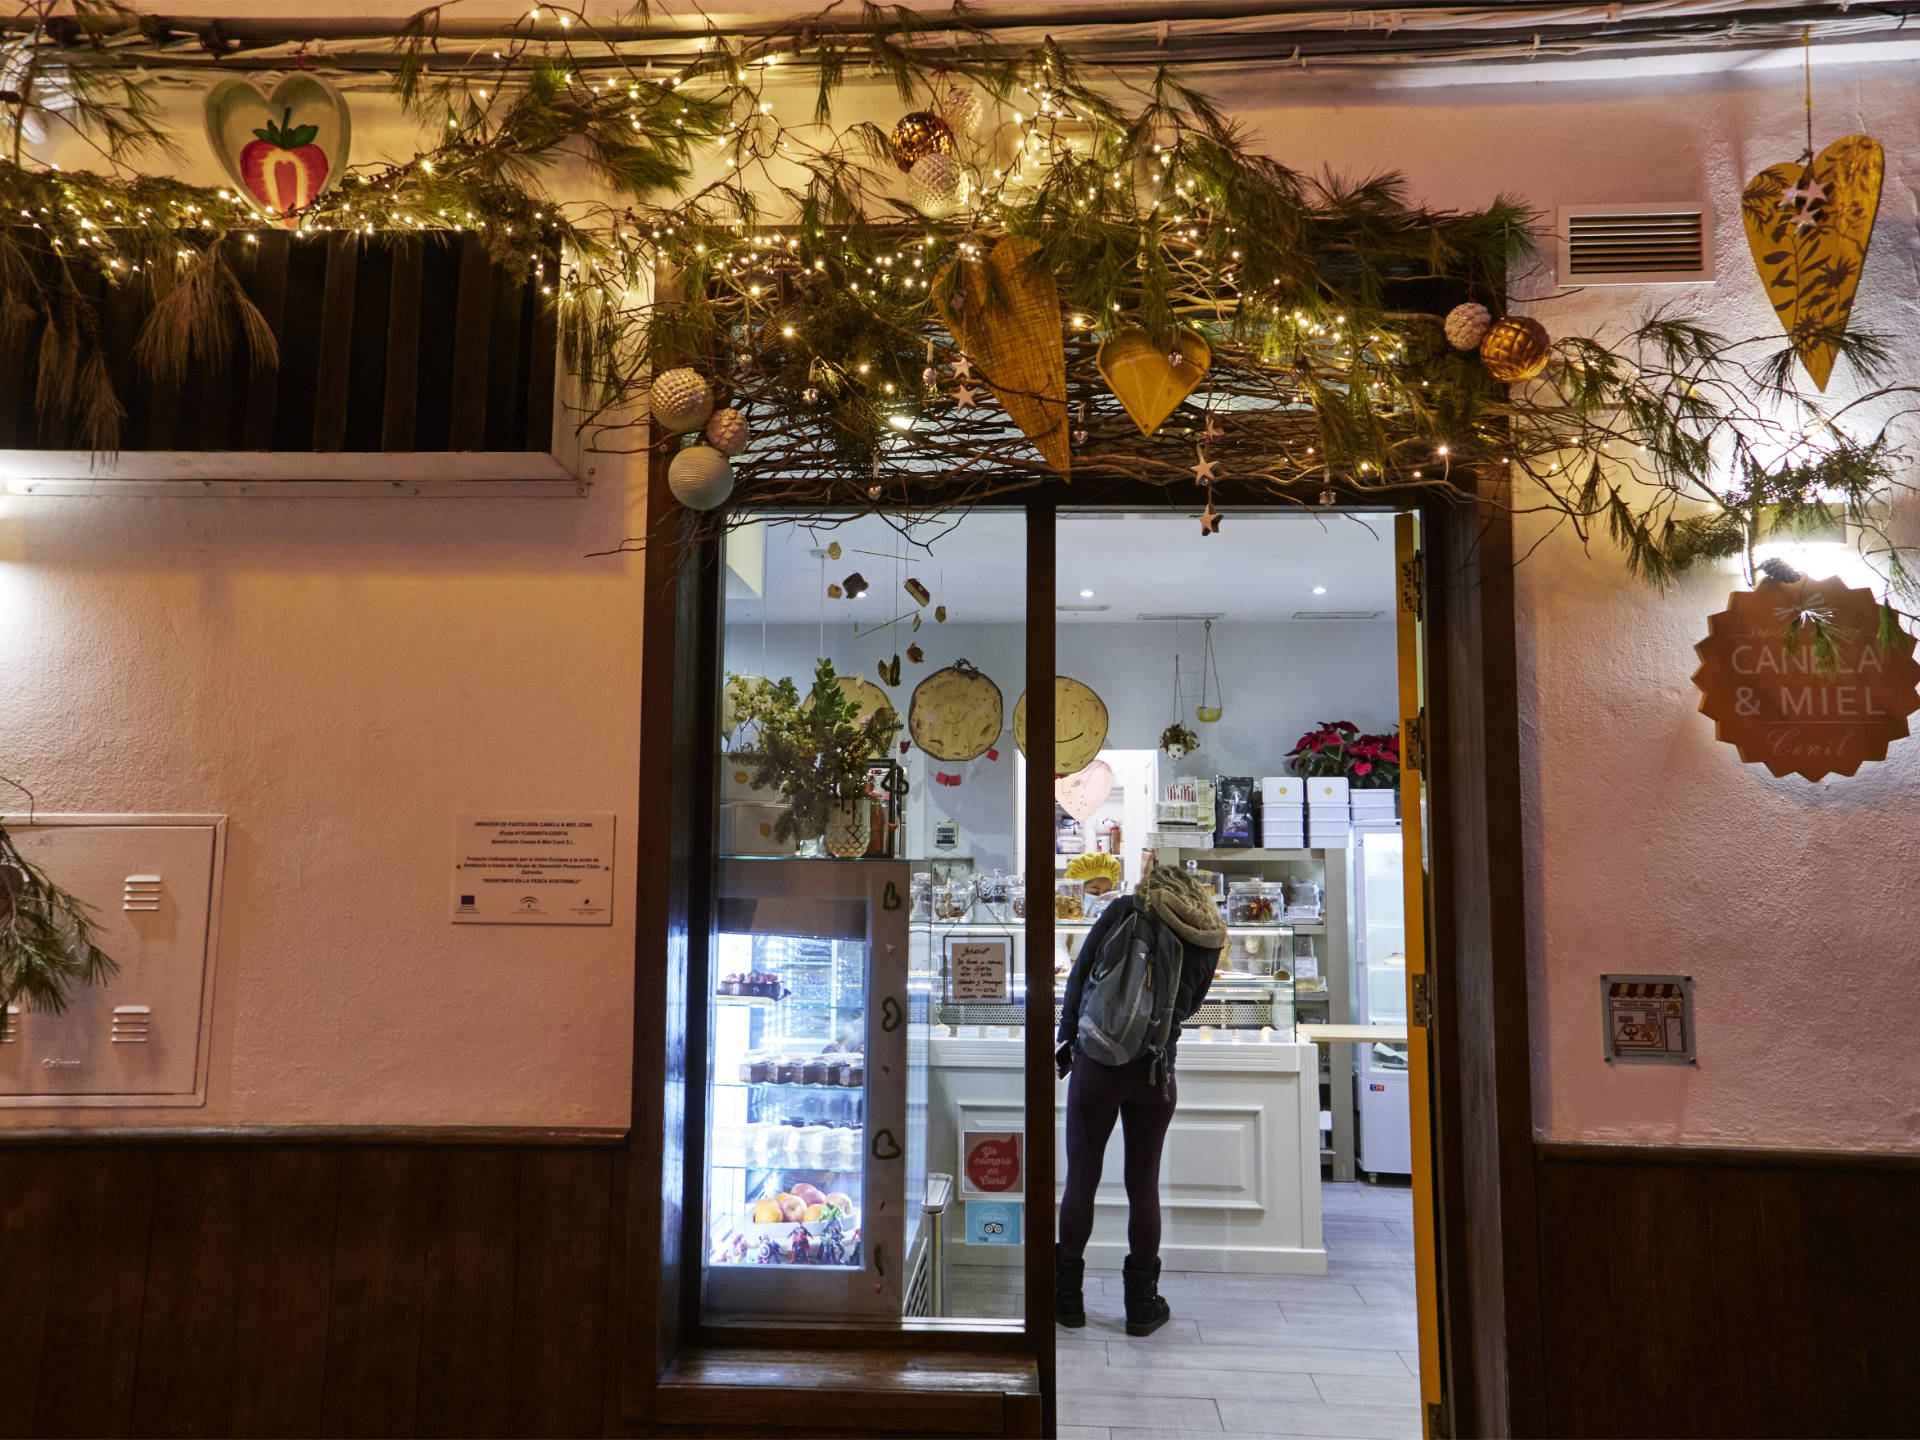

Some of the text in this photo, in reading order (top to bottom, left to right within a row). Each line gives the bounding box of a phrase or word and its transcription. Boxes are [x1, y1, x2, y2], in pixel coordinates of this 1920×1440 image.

[1735, 686, 1887, 716] & MIEL
[1767, 727, 1856, 757] Conil
[981, 1145, 997, 1157] Yo
[987, 1167, 998, 1175] en
